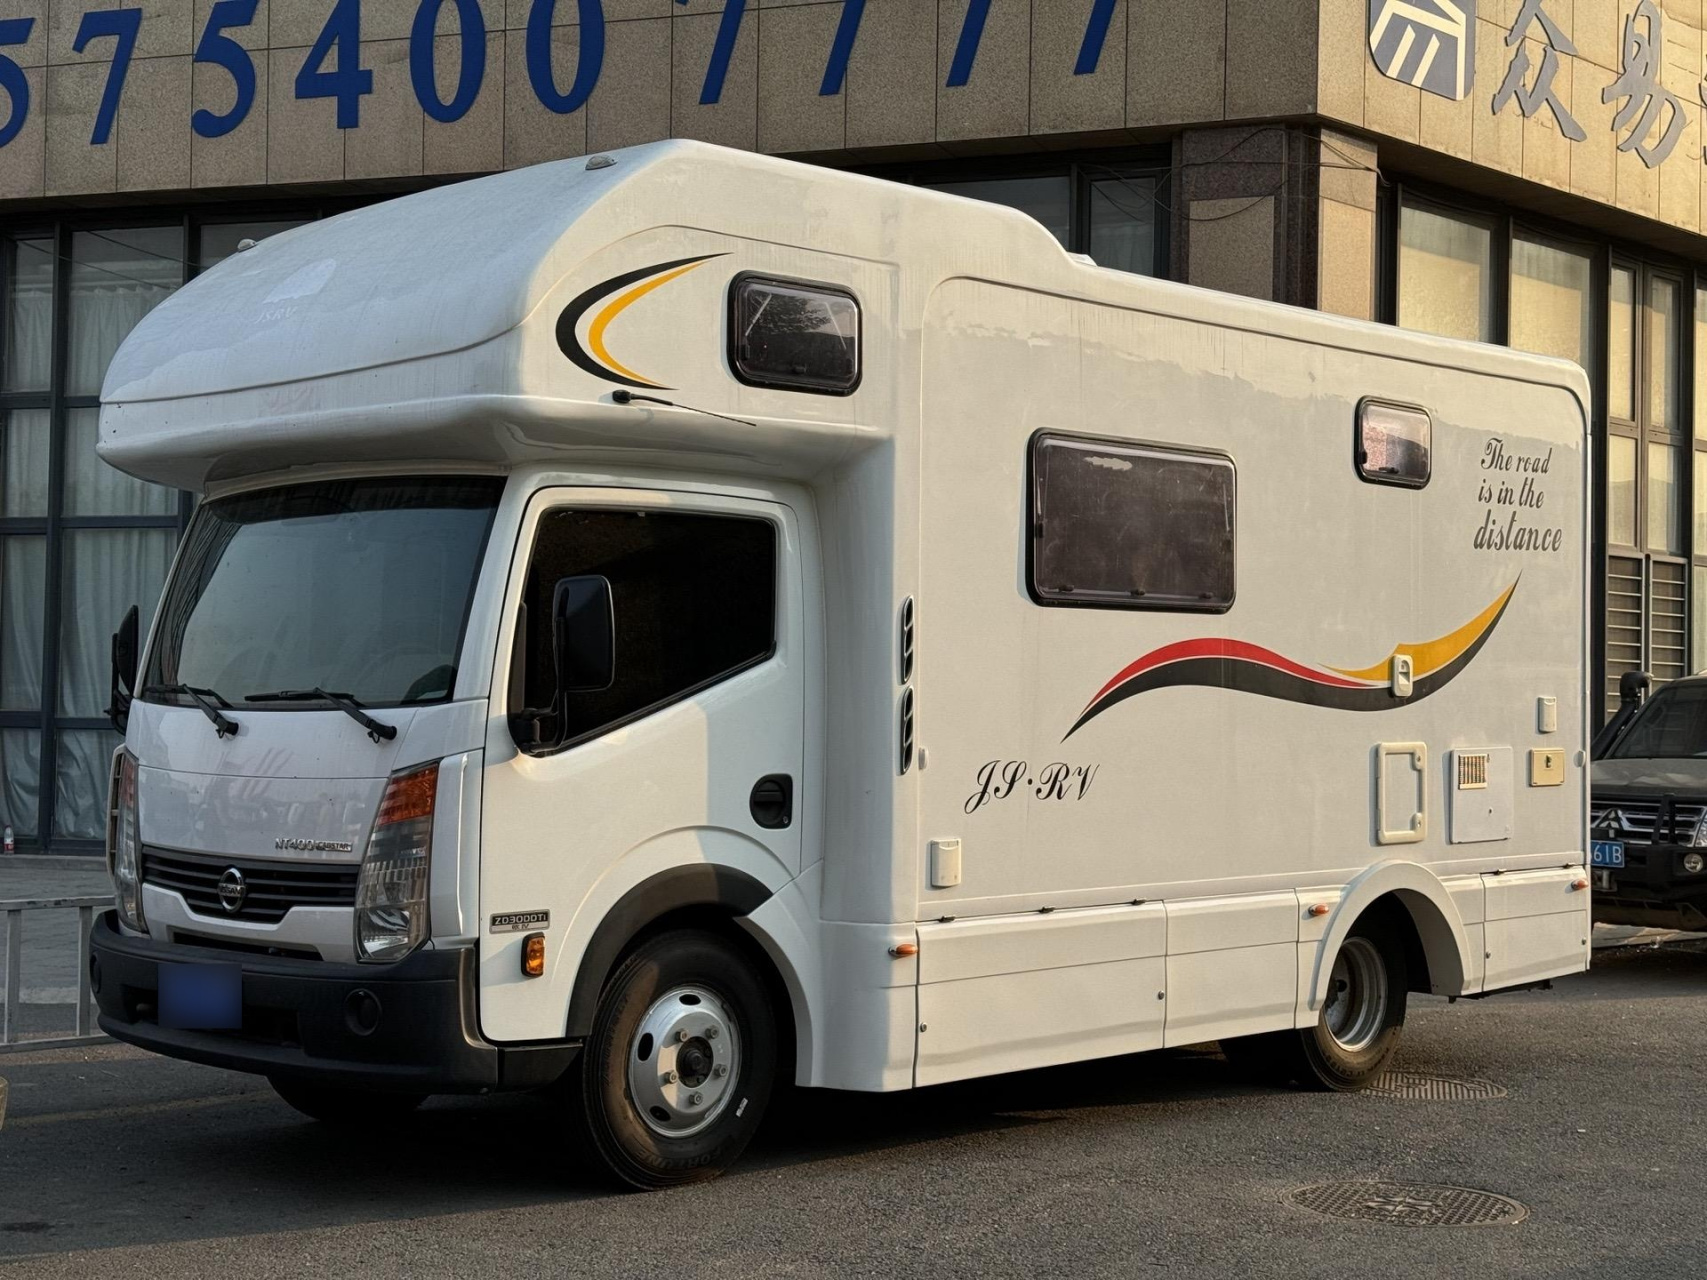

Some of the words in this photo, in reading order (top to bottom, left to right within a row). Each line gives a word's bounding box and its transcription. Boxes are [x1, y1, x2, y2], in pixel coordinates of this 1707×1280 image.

[1492, 0, 1707, 169] 众易
[1481, 437, 1513, 472] The
[1516, 447, 1553, 474] road
[1478, 478, 1493, 504] is
[1497, 480, 1515, 505] in
[1519, 476, 1545, 509] the
[1473, 508, 1562, 552] distance
[275, 838, 315, 851] NT400
[1591, 844, 1622, 864] 61B
